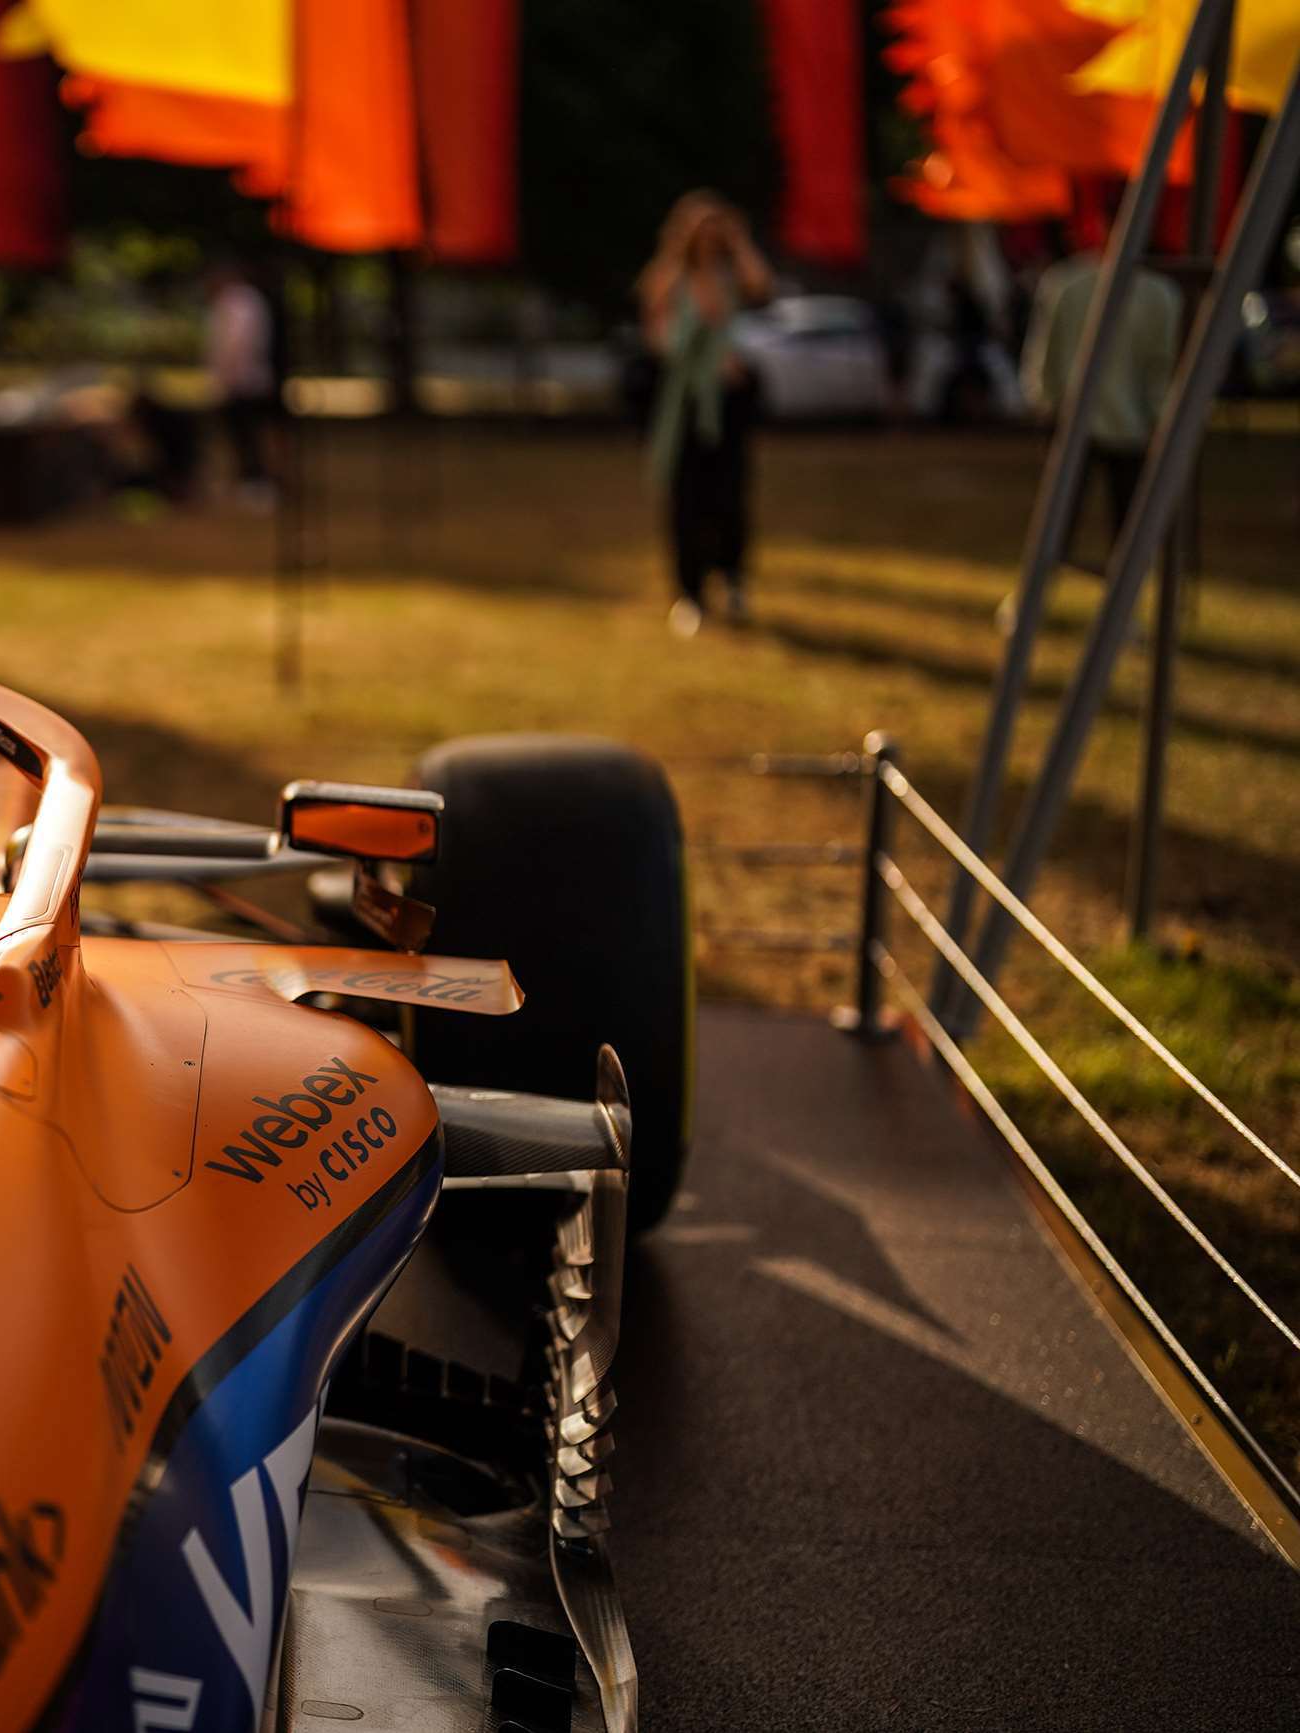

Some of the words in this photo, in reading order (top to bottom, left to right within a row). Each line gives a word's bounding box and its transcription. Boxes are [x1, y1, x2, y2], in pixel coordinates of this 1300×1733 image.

[205, 1055, 379, 1185] webex
[286, 1169, 333, 1212] by
[318, 1106, 398, 1183] CISCO
